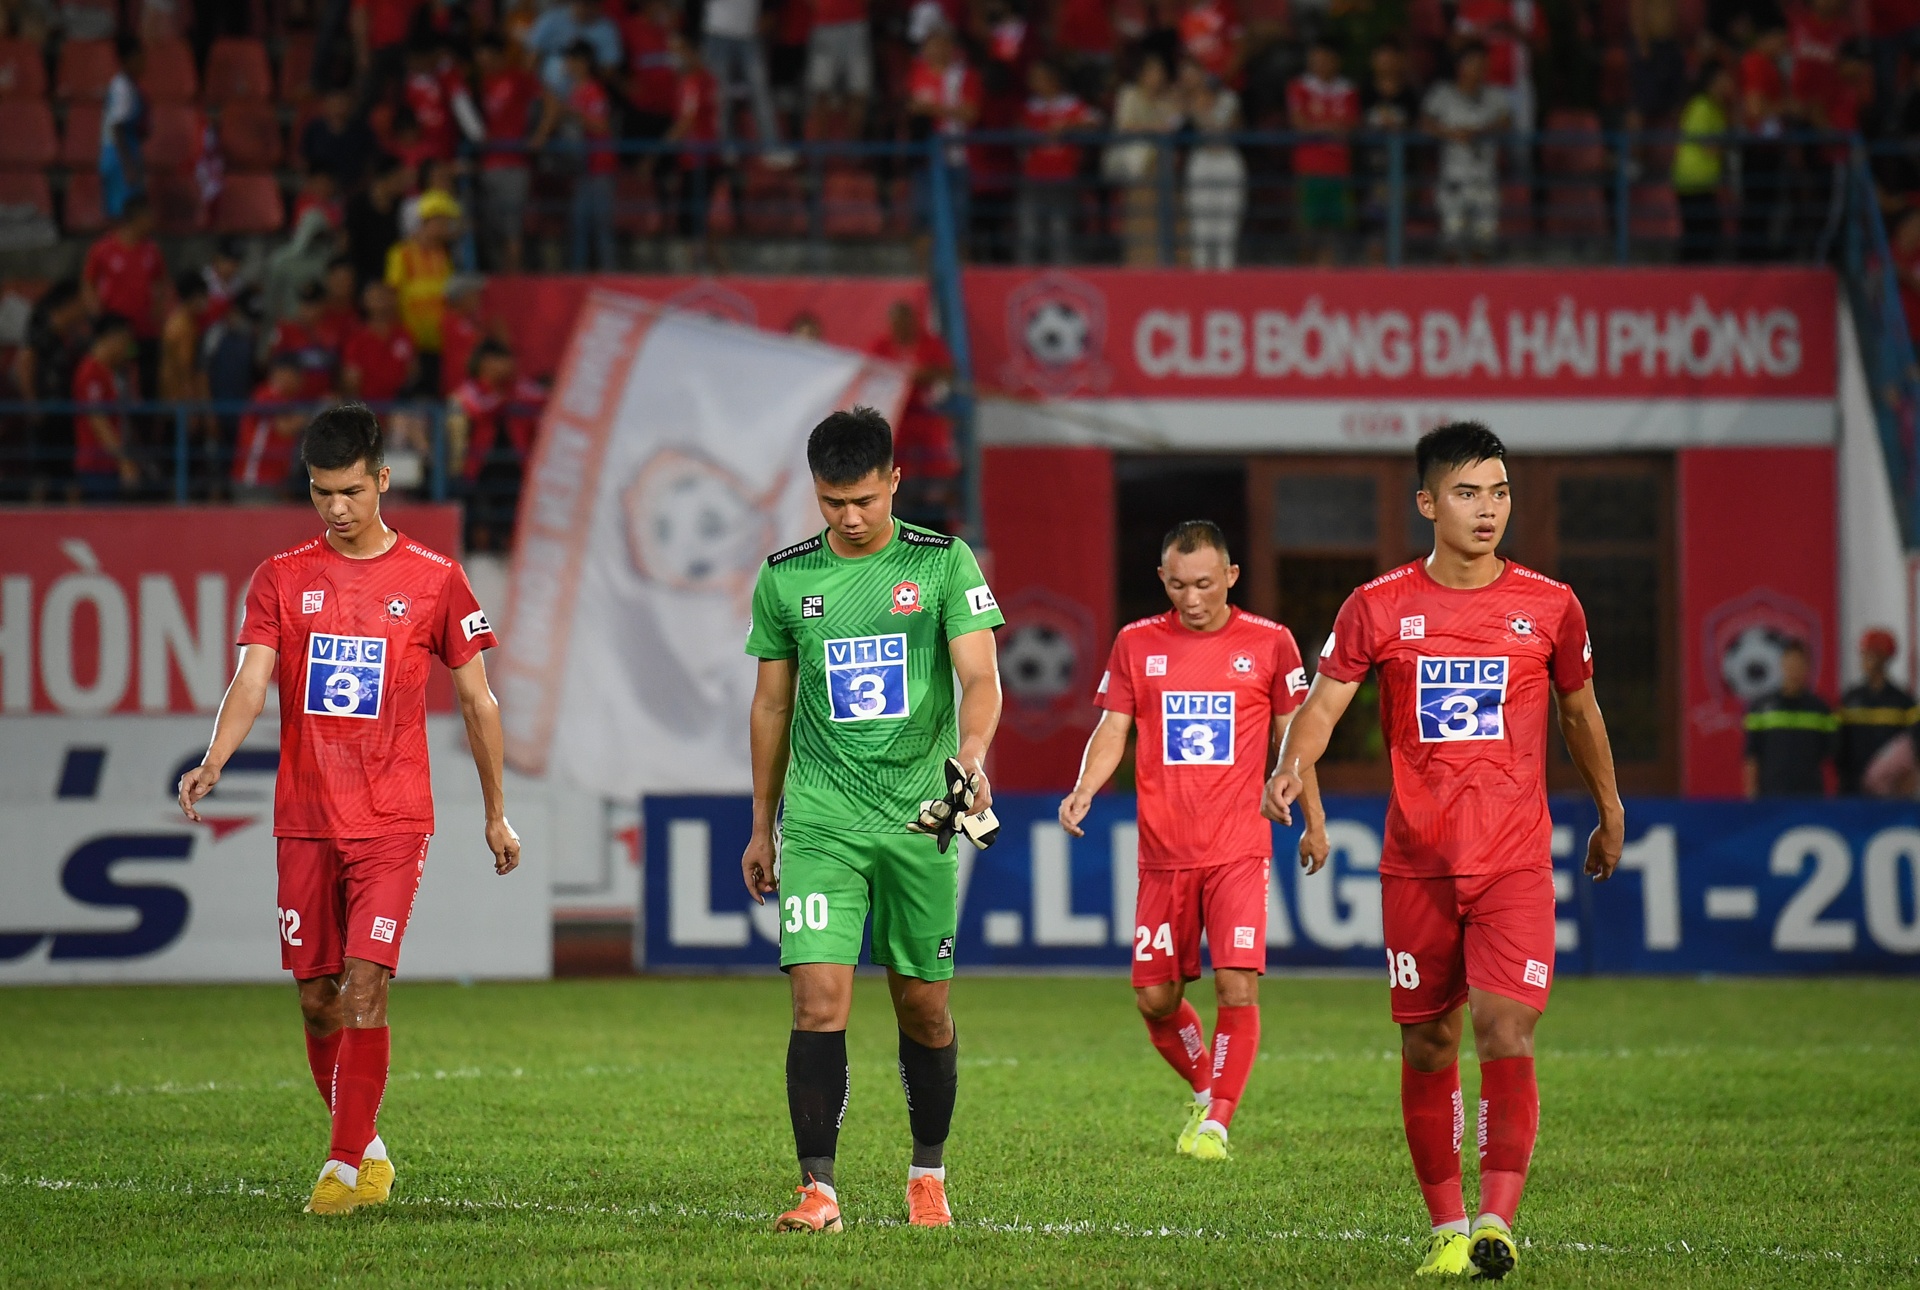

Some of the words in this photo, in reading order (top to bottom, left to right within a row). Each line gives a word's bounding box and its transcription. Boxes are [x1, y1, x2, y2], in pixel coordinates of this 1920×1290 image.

[1134, 308, 1246, 378] CLB
[1252, 294, 1414, 378] BÓNG
[1420, 295, 1499, 378] ĐÁ
[1508, 294, 1598, 378] HẢI
[1606, 293, 1801, 378] PHÒNG
[903, 531, 950, 546] JOGARBOLA
[405, 542, 453, 568] JOGARBOLA
[771, 538, 820, 563] JOGARBOLA
[1362, 566, 1414, 592] JOGARBOLA
[1513, 567, 1568, 591] JOGARBOLA
[304, 592, 322, 602] JG
[304, 602, 321, 612] BL
[804, 596, 823, 607] JG
[804, 606, 823, 617] BL
[1237, 612, 1284, 632] JOGARBOLA
[1404, 617, 1422, 628] JG
[1402, 628, 1423, 638] BL
[316, 638, 379, 661] VTC
[830, 640, 899, 663] VTC
[1424, 662, 1500, 682] VTC
[322, 672, 360, 715] 3
[849, 673, 887, 718] 3
[1168, 696, 1228, 713] VTC
[1438, 695, 1479, 738] 3
[1180, 723, 1215, 762] 3
[784, 891, 829, 934] 30
[373, 928, 391, 941] BL
[375, 918, 395, 931] JG
[1135, 922, 1175, 962] 24
[1526, 974, 1545, 985] BL
[1528, 962, 1546, 976] JG
[1212, 1032, 1231, 1079] JOGARBOLA
[1477, 1098, 1489, 1159] JOGARBOLA
